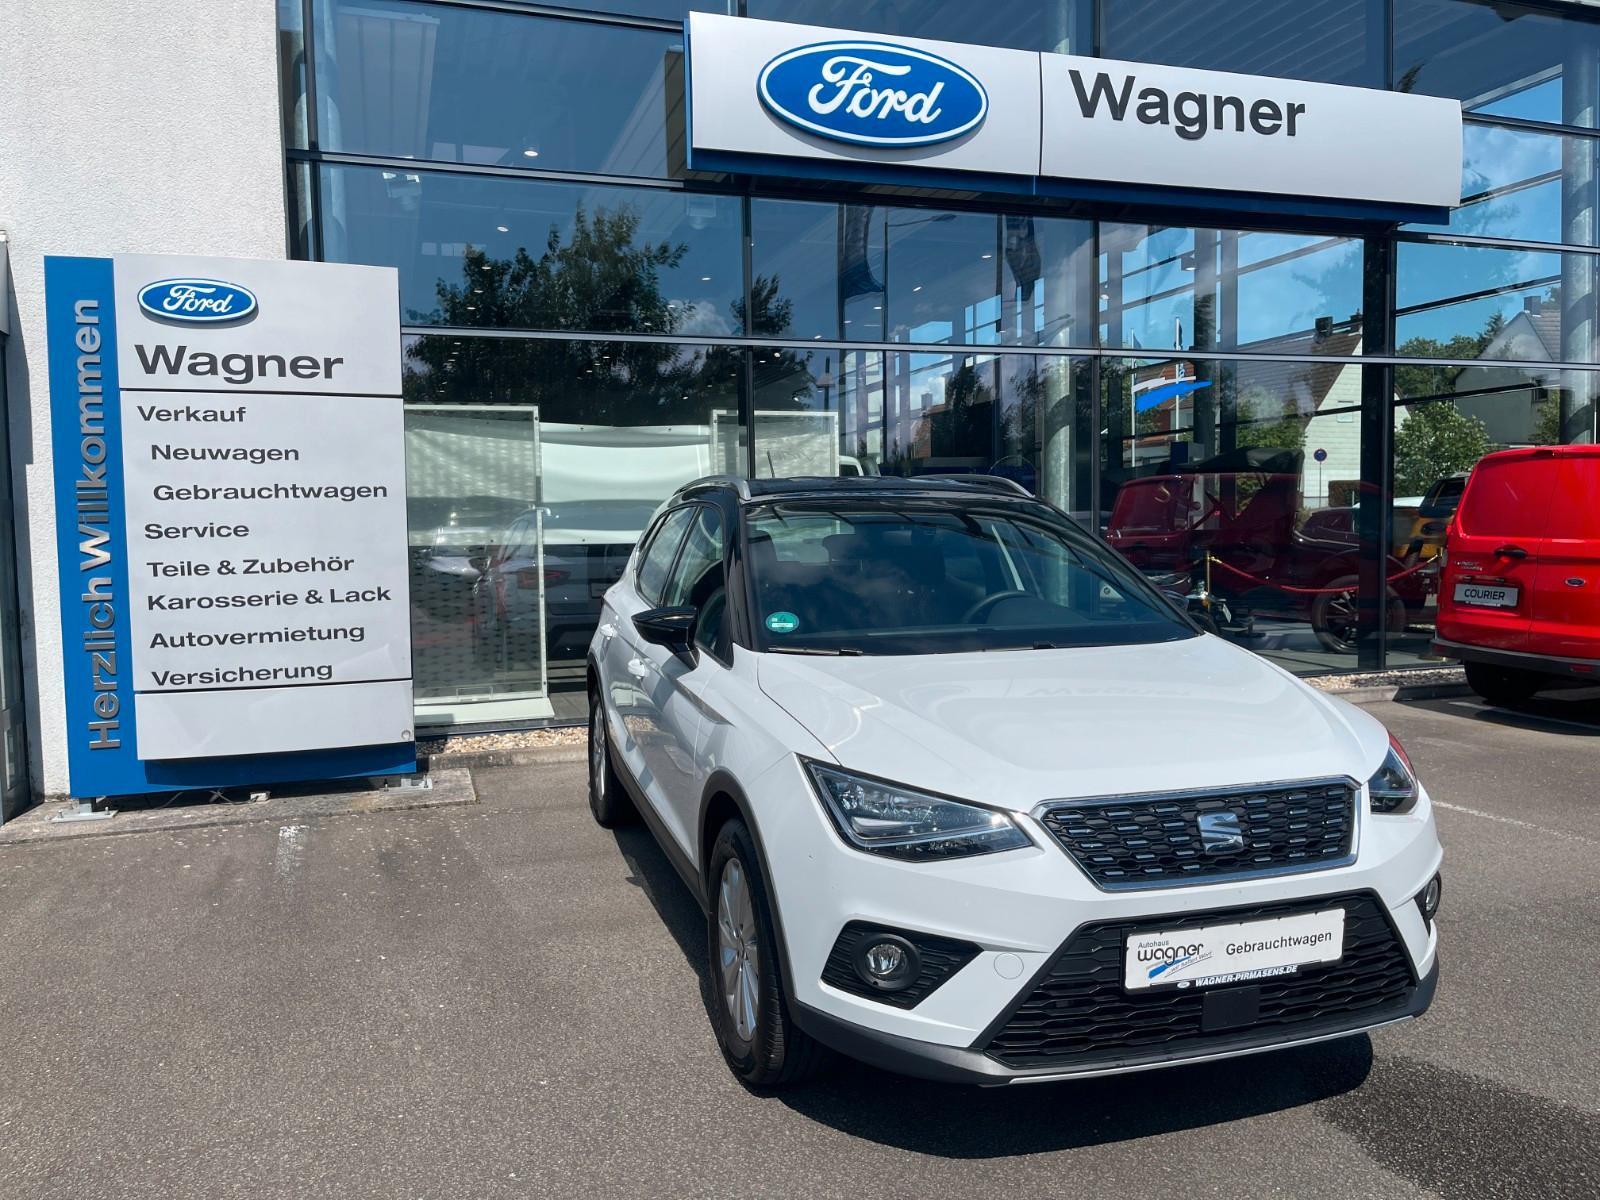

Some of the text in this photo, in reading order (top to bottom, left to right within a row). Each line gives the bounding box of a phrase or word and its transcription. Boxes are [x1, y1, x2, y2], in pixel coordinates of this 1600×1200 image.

[807, 55, 942, 127] Ford
[1069, 70, 1306, 140] Wagner
[162, 284, 234, 313] Ford
[134, 344, 344, 385] Wagner
[137, 405, 247, 423] Verkauf
[151, 444, 300, 465] Neuwagen
[153, 482, 388, 503] Gebrauchtwagen
[75, 299, 121, 750] Herzlich Willkommen
[144, 522, 250, 540] Service
[147, 556, 355, 578] Teile & Zubehör
[148, 586, 392, 611] Karosserie & Lack
[1464, 588, 1506, 601] COURIER
[150, 623, 365, 649] Autovermietung
[152, 661, 333, 686] Versicherung
[1137, 943, 1204, 966] wagner
[1138, 939, 1170, 949] Autohaus
[1225, 931, 1333, 957] Gebrauchtwagen
[1195, 965, 1298, 987] WAGNER-PIRMASENS.DE
